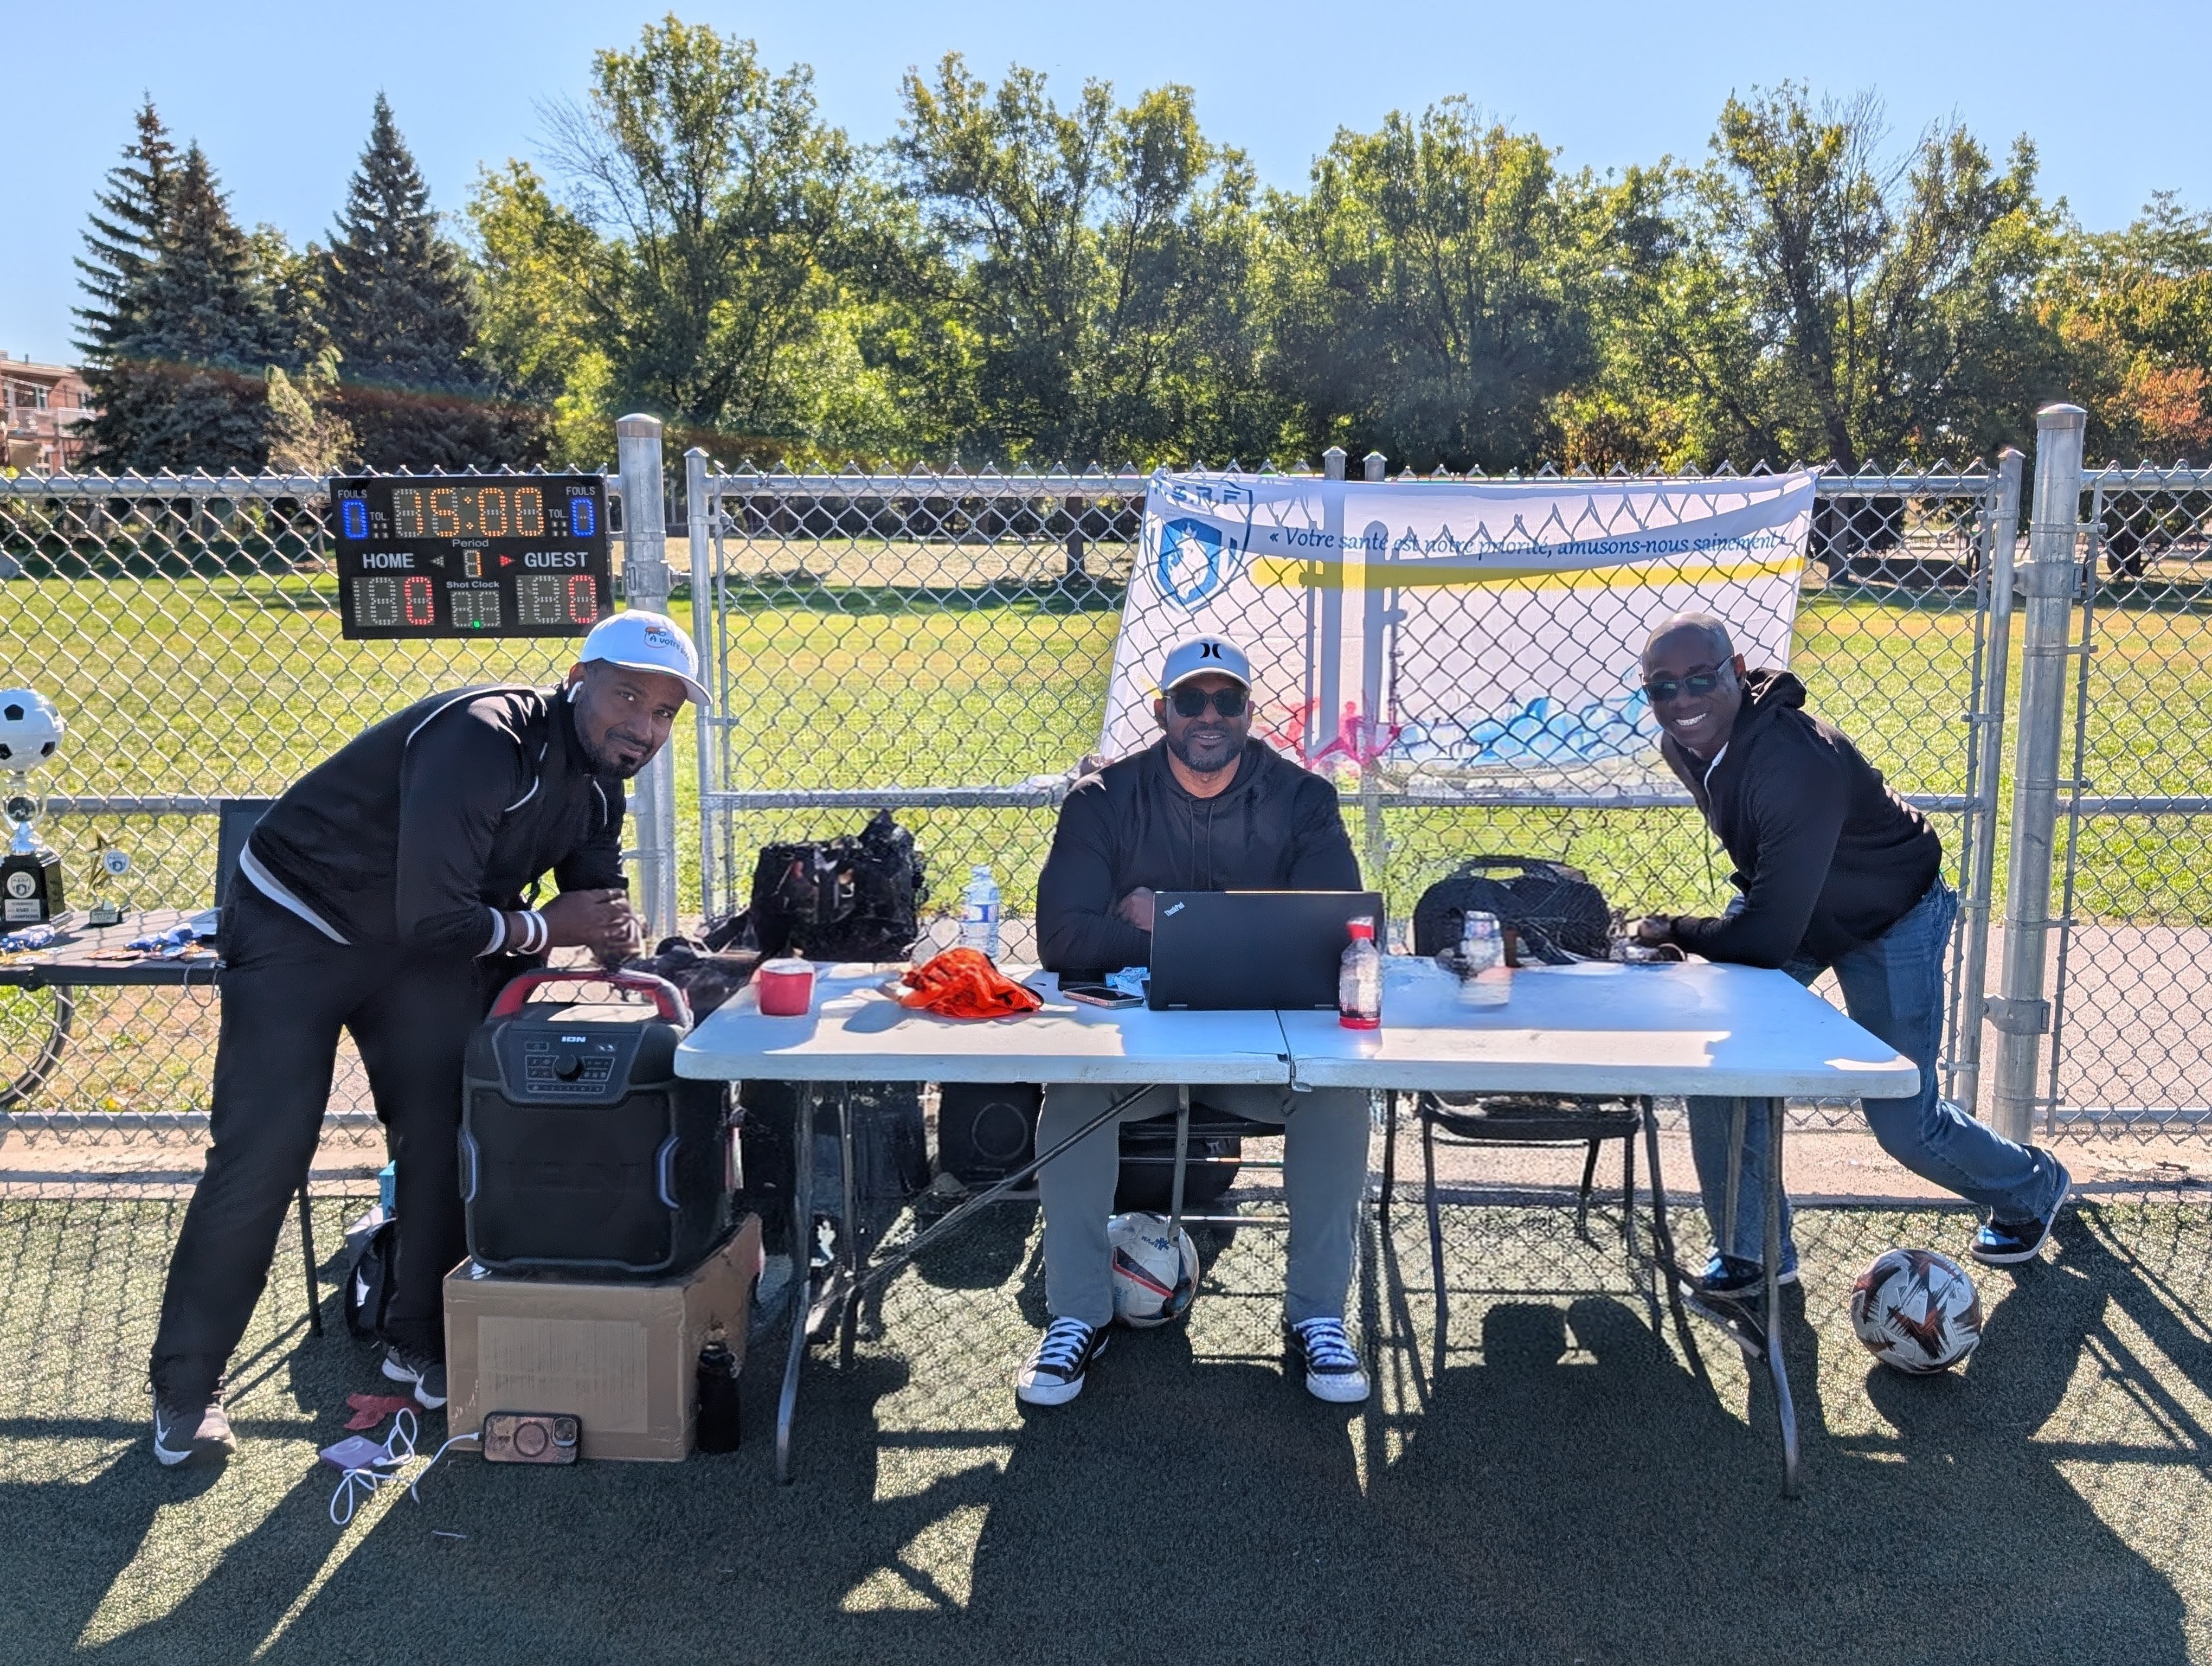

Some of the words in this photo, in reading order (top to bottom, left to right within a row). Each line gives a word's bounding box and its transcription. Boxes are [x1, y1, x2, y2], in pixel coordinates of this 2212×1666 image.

[338, 489, 367, 498] FOULS
[566, 486, 595, 496] FOULS
[342, 498, 368, 540] 0
[370, 511, 389, 521] TOL.
[548, 509, 568, 519] TOL.
[570, 497, 595, 537] 0
[452, 538, 489, 548] Period
[1285, 527, 1334, 548] Votre
[1339, 531, 1389, 550] santé
[1393, 534, 1419, 552] est
[1425, 535, 1474, 553] notre
[1557, 539, 1689, 555] amusons-nous
[1693, 531, 1776, 552] sainement
[362, 553, 415, 569] HOME
[524, 552, 588, 568] GUEST
[446, 580, 470, 588] Shot
[472, 581, 500, 589] Clock
[404, 576, 435, 626] 0
[568, 574, 598, 624] 0
